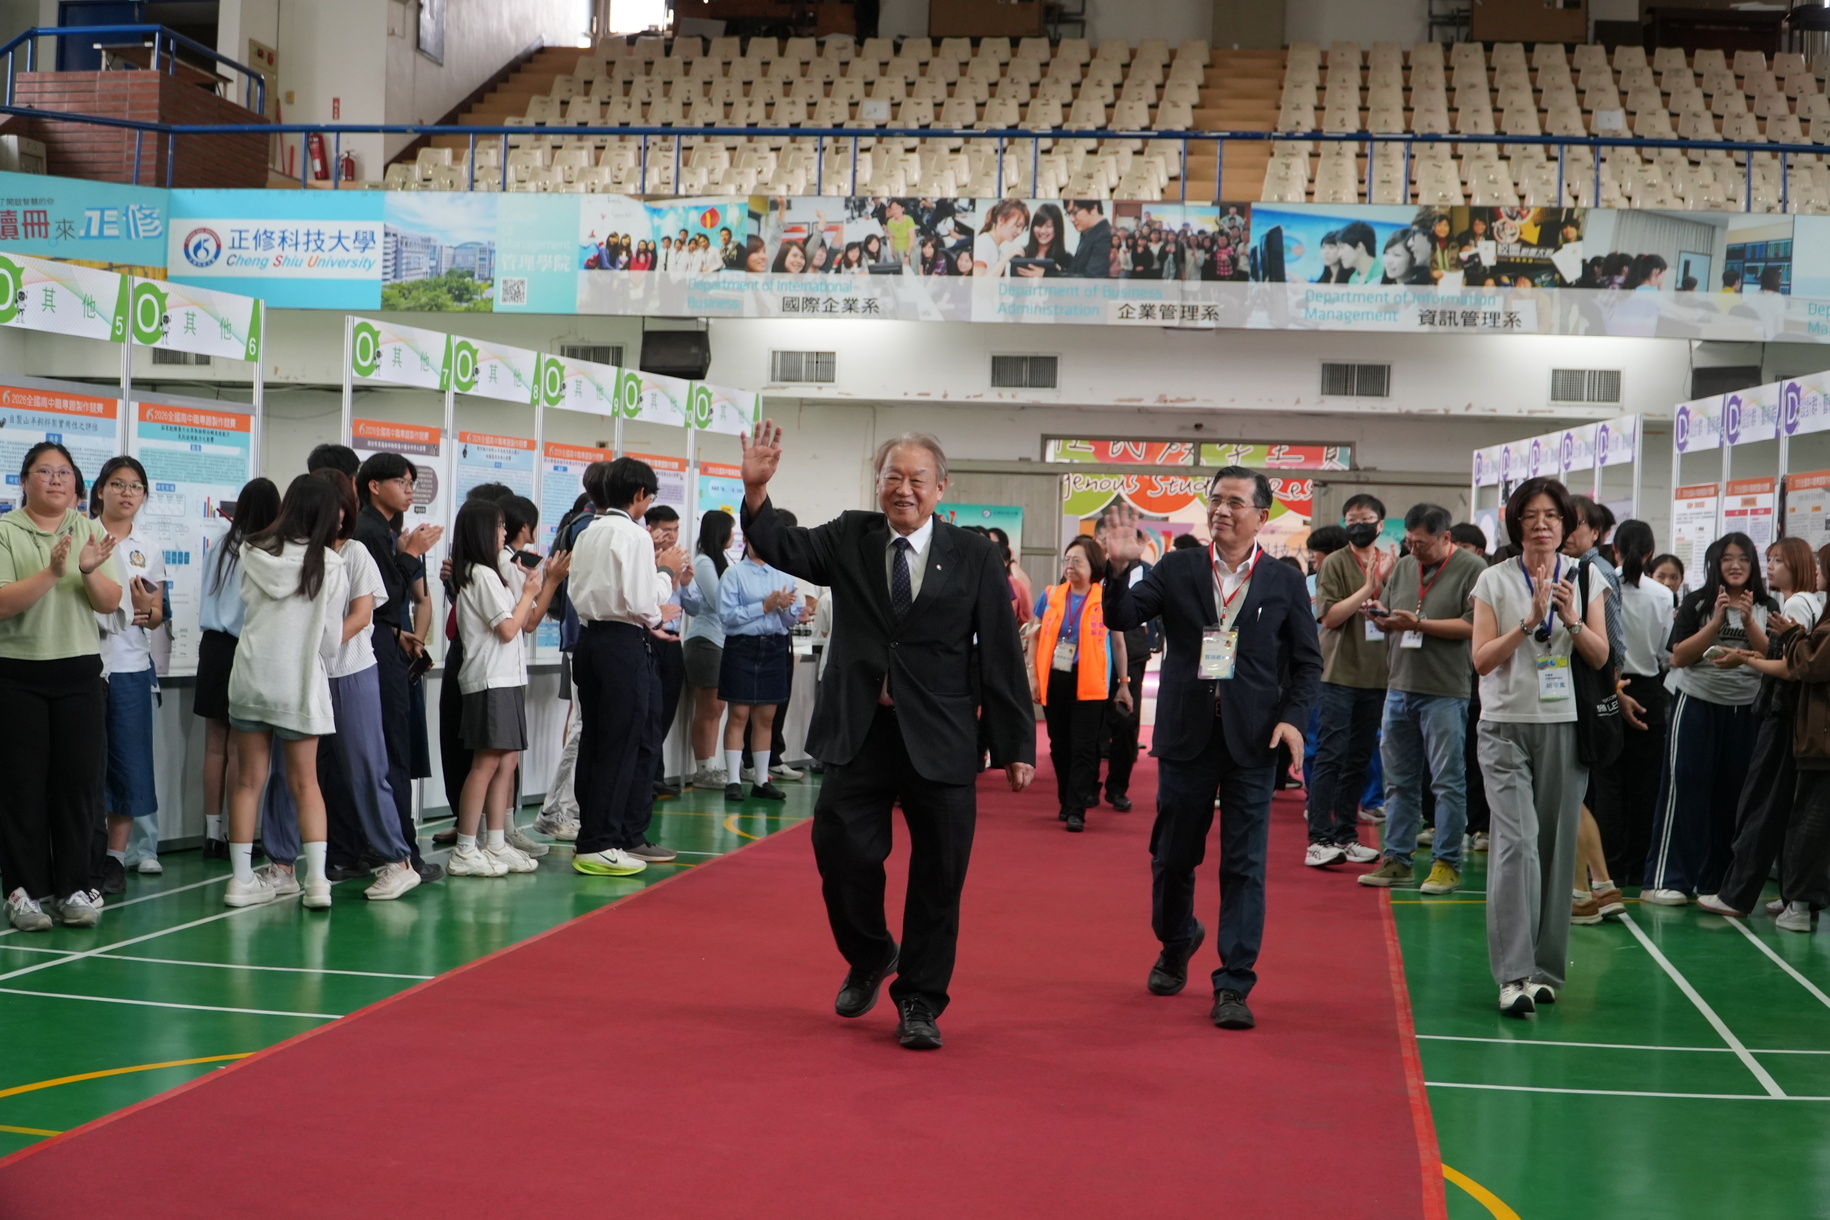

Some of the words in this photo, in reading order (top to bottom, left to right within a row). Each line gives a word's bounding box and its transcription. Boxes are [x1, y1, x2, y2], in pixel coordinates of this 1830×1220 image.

[228, 228, 376, 253] 正修科技大學
[227, 254, 270, 269] Cheng
[273, 254, 304, 268] Shiu
[307, 255, 377, 272] University
[501, 253, 571, 273] 管理學院
[687, 278, 758, 294] Department
[762, 279, 776, 292] of
[778, 280, 853, 293] International
[998, 283, 1079, 300] Department
[1083, 283, 1098, 297] of
[1103, 284, 1163, 300] Business
[687, 296, 740, 310] Business
[782, 297, 880, 314] 國際企業系
[1304, 289, 1390, 306] Department
[1393, 289, 1410, 304] of
[1412, 291, 1496, 307] Information
[41, 287, 96, 319] 其他
[115, 316, 123, 336] 5
[997, 302, 1100, 316] Administration
[1118, 303, 1220, 321] 企業管理系
[1304, 308, 1398, 325] Management
[1418, 309, 1522, 329] 資訊管理系
[136, 293, 160, 333] O
[183, 311, 232, 341] 其他
[249, 337, 257, 356] 6
[1807, 321, 1830, 335] Ma
[356, 331, 374, 367] O
[391, 346, 430, 373] 其他
[442, 369, 449, 385] 7
[456, 349, 473, 383] O
[488, 364, 523, 388] 其他
[532, 384, 539, 400] 8
[545, 366, 561, 398] O
[574, 379, 604, 401] 其他
[613, 397, 619, 412] 9
[625, 380, 639, 410] O
[649, 393, 678, 413] 其他
[696, 393, 709, 421] O
[719, 404, 746, 424] 其他
[1787, 392, 1798, 425] D
[1678, 414, 1688, 443] D
[1729, 404, 1739, 435] D
